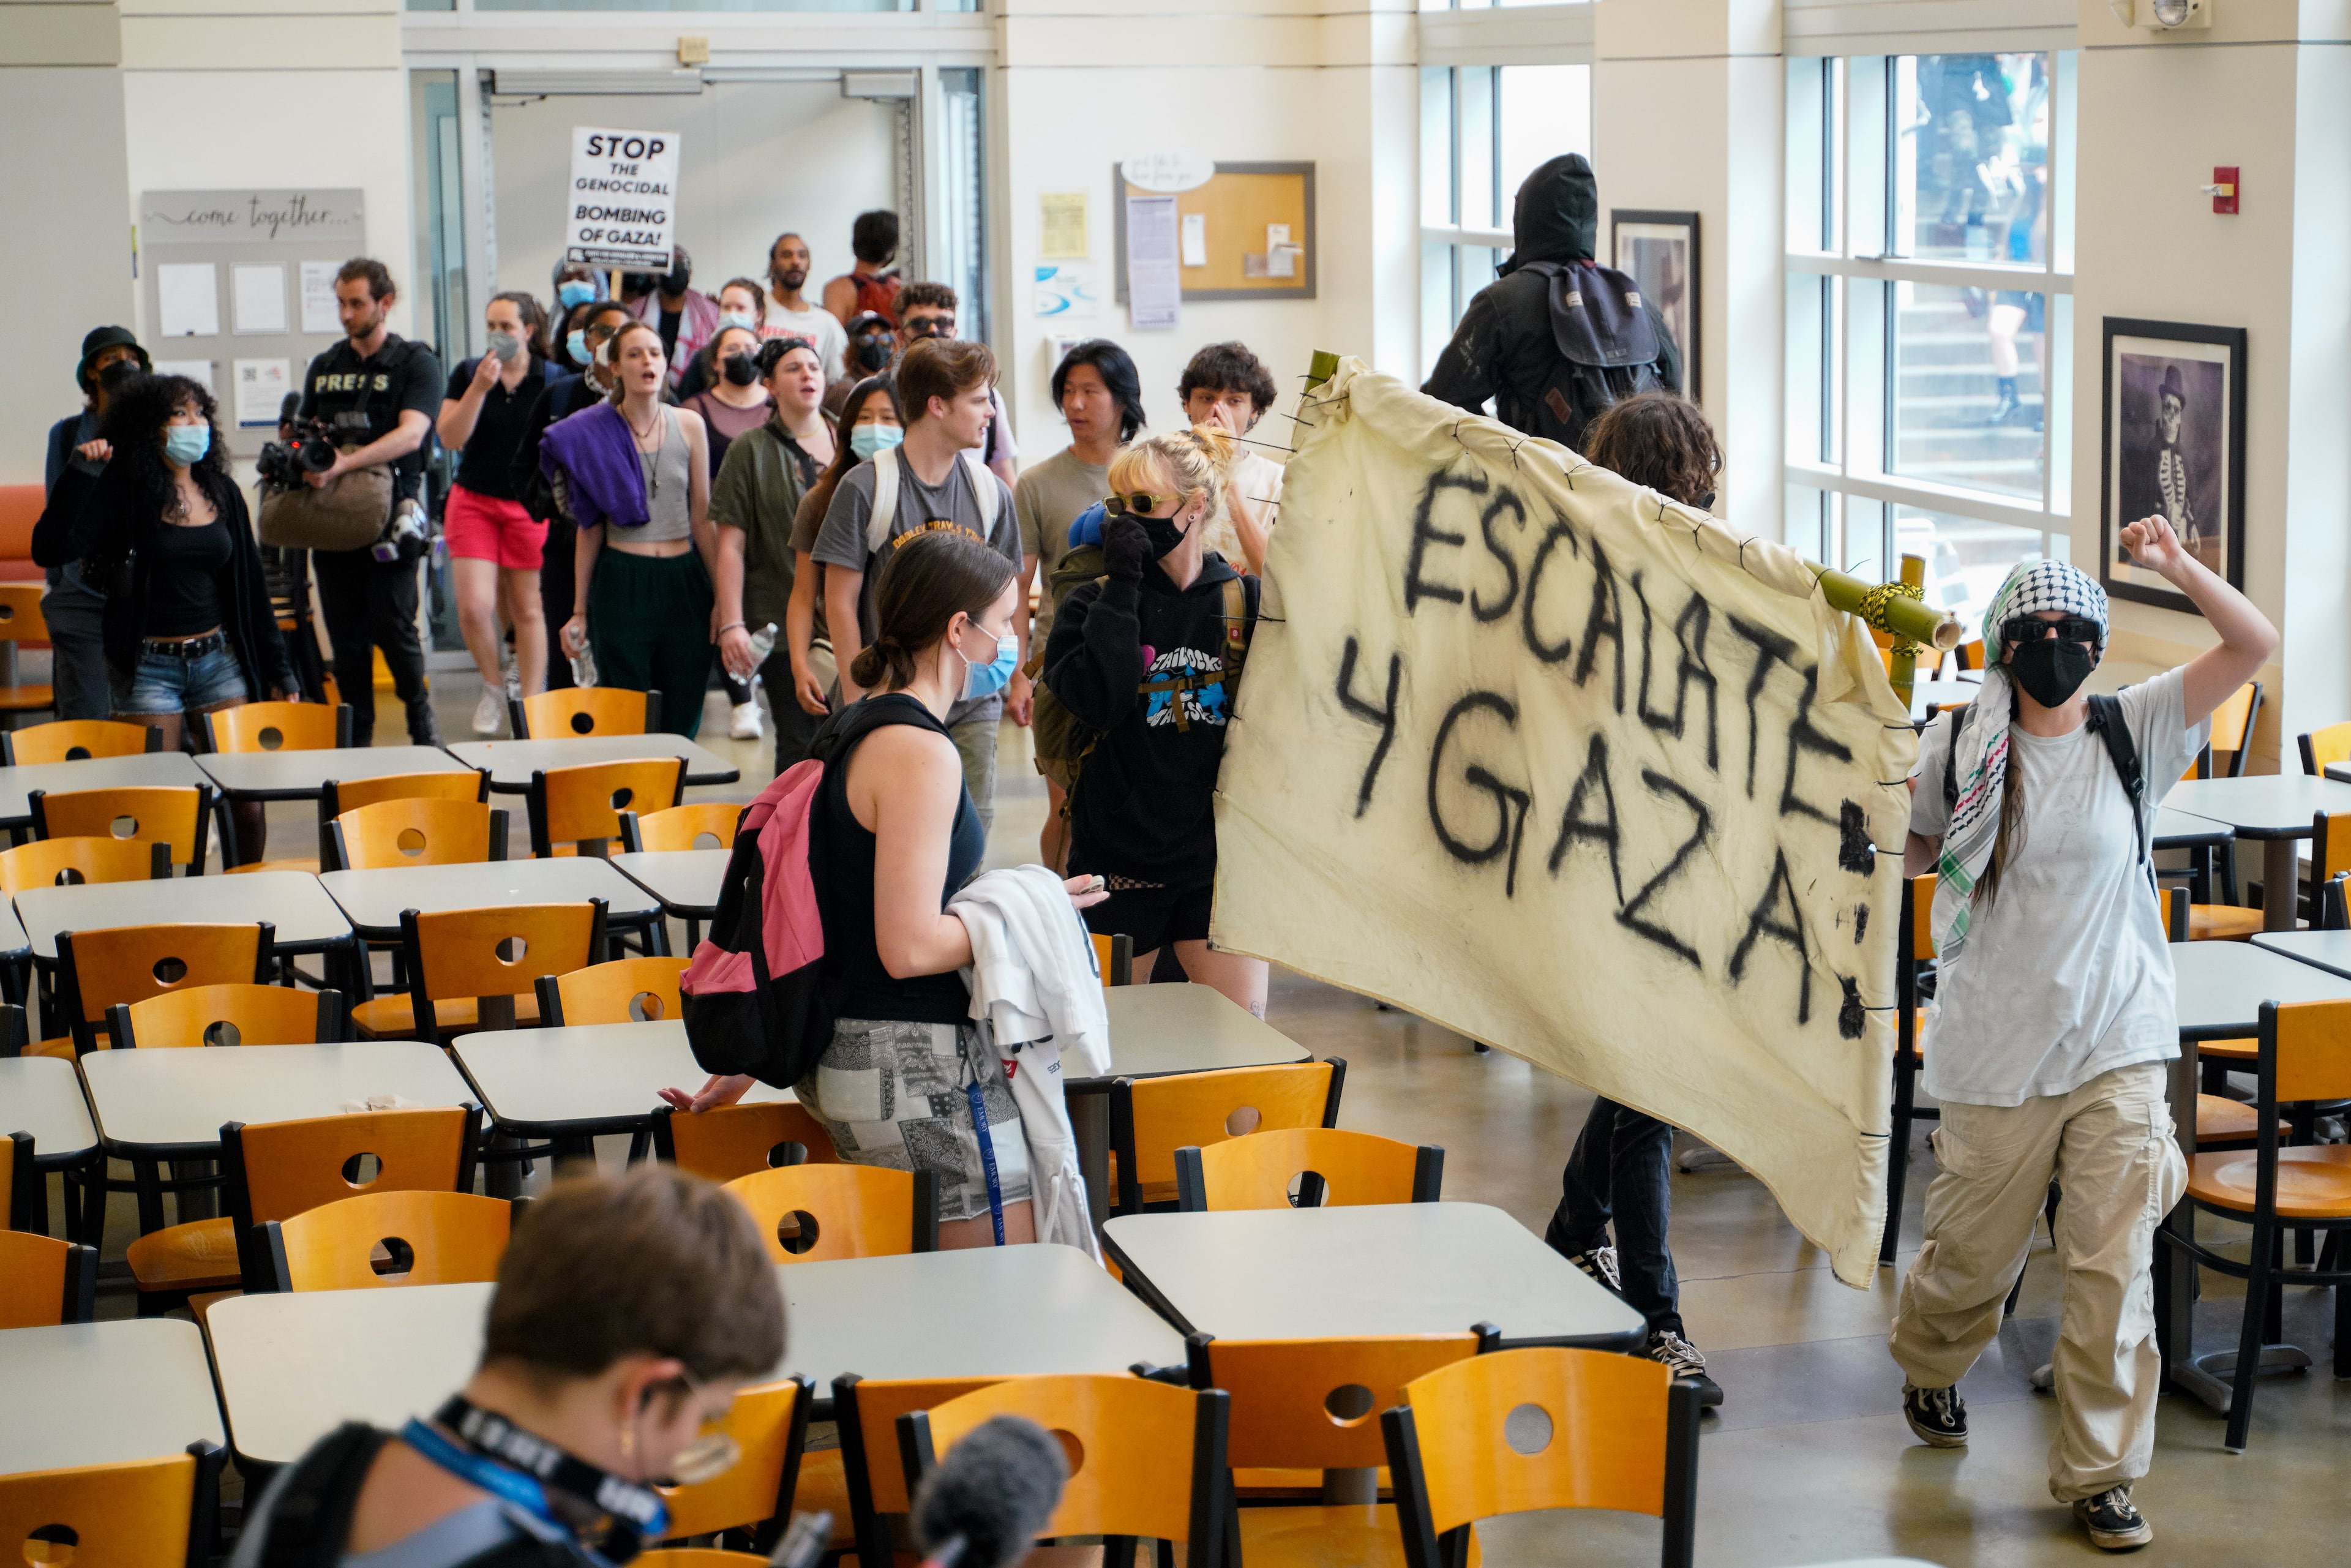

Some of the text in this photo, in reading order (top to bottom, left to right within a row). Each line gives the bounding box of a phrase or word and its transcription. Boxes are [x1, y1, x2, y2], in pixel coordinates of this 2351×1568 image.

[587, 134, 665, 160] STOP
[610, 162, 639, 176] THE
[576, 178, 669, 195] GENOCIDAL
[179, 209, 235, 227] come
[574, 204, 666, 225] BOMBING
[579, 227, 662, 246] OF GAZA!
[1404, 467, 1853, 829] ESCALATE
[1335, 634, 1810, 1024] 4 GAZA
[977, 1107, 988, 1132] EMORY
[989, 1163, 999, 1188] EMORY
